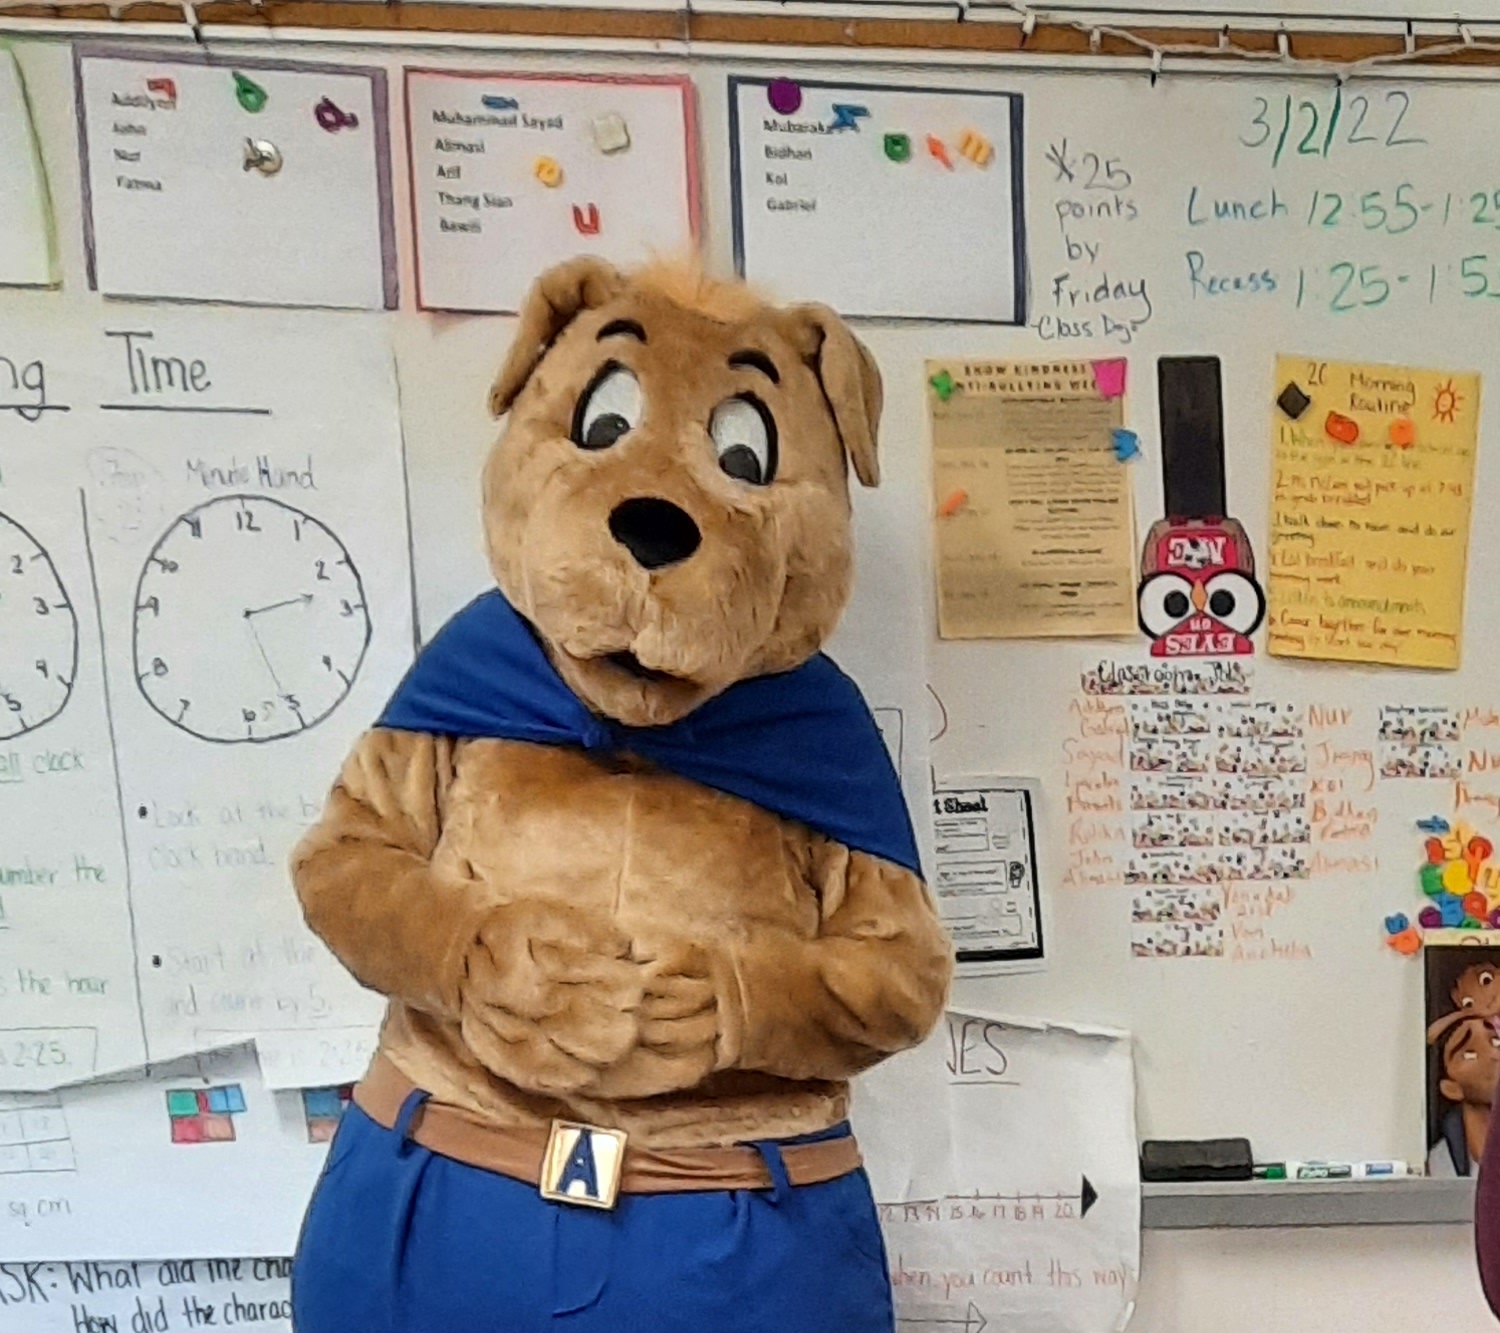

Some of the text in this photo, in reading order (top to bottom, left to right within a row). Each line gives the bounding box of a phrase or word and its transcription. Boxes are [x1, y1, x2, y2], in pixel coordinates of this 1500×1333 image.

[1239, 89, 1428, 168] 3/2/22
[1055, 195, 1138, 232] points
[1188, 186, 1289, 226] Lunch
[1065, 235, 1099, 264] by
[1186, 250, 1278, 299] Recess
[1052, 272, 1152, 325] Friday
[955, 381, 1062, 393] NTI-BULLYING
[1165, 633, 1237, 656] EYES
[556, 1127, 600, 1198] A
[0, 1260, 58, 1305] SK:
[65, 1262, 142, 1295] What
[182, 1294, 217, 1328] the
[223, 1292, 292, 1327] charac
